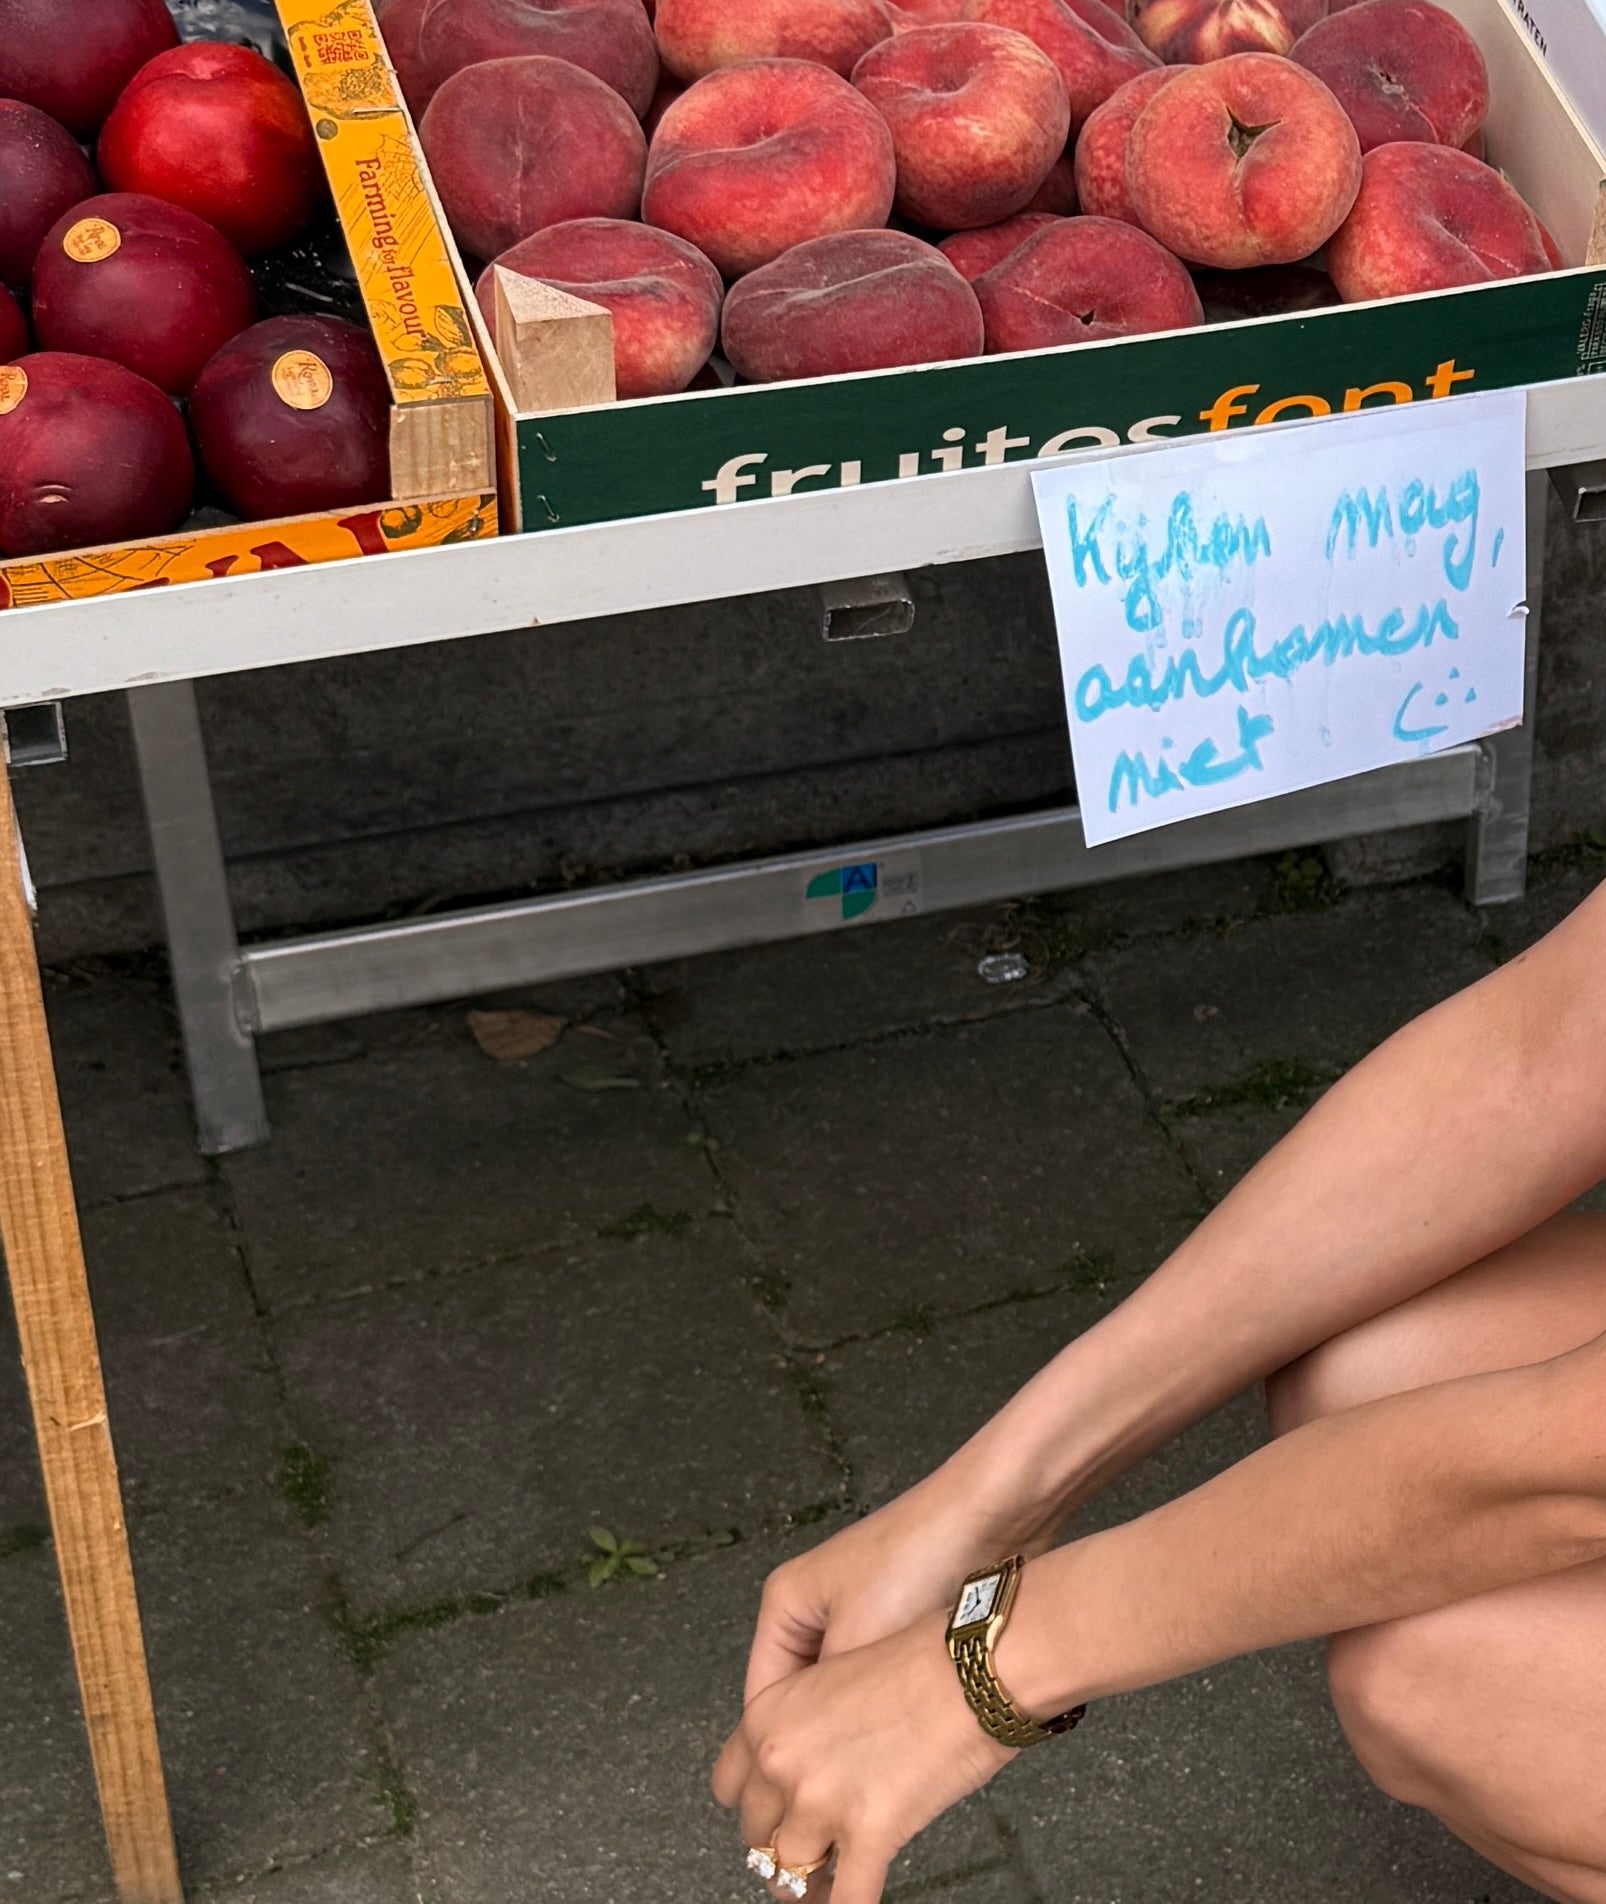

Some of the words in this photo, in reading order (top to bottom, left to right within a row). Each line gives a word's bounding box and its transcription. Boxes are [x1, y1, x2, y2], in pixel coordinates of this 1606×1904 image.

[355, 157, 399, 249] Farming
[386, 265, 428, 339] flavour
[1108, 704, 1274, 813] niet
